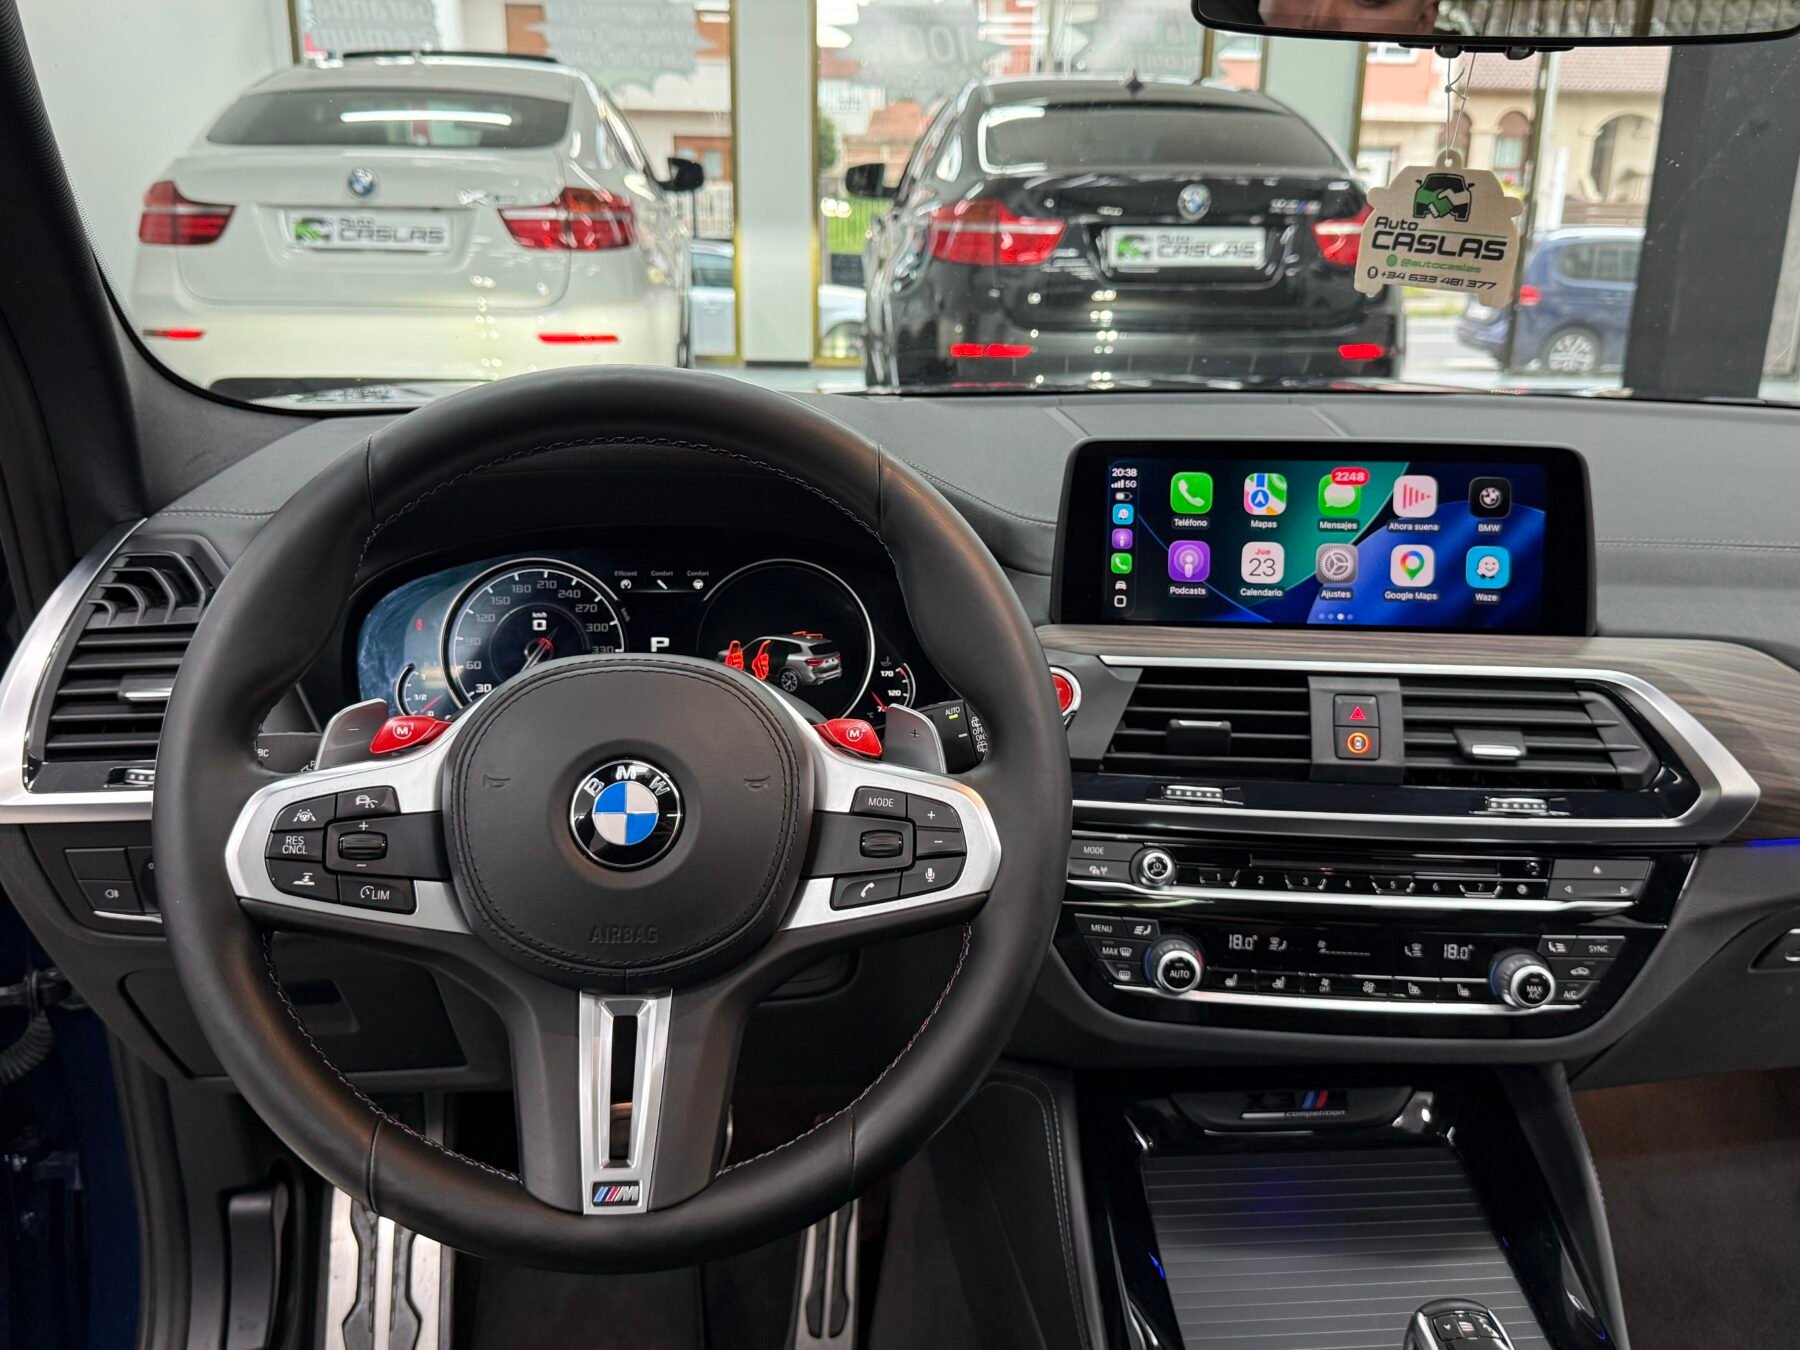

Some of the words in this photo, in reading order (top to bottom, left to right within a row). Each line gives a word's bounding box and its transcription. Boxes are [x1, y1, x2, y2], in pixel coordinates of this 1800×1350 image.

[1374, 216, 1418, 231] Auto
[340, 226, 445, 243] CASLAS
[1371, 230, 1507, 261] CASLAS
[1400, 258, 1482, 273] @autocaslas
[1381, 271, 1405, 280] +34
[1408, 274, 1437, 284] 633
[1440, 277, 1464, 287] 481
[1466, 279, 1497, 290] 377
[1111, 468, 1137, 477] 20:38
[1334, 472, 1365, 482] 2248
[1125, 480, 1137, 488] 5G
[1173, 518, 1208, 528] Teléfono
[1251, 520, 1278, 529] Mapas
[1320, 521, 1357, 531] Mensajes
[1389, 523, 1413, 531] Ahora
[1478, 524, 1500, 532] BMW
[1249, 558, 1276, 577] 23
[512, 584, 532, 593] 180
[537, 580, 557, 589] 210
[558, 589, 581, 598] 240
[1170, 586, 1206, 595] Podcasts
[1240, 588, 1283, 597] Calendario
[1321, 590, 1351, 599] Ajustes
[491, 596, 510, 605] 150
[1385, 591, 1413, 601] Google
[1414, 592, 1438, 601] Maps
[1475, 594, 1498, 602] Waze
[575, 604, 597, 613] 270
[476, 613, 495, 622] 120
[532, 619, 547, 631] 0
[586, 623, 608, 632] 300
[650, 637, 670, 652] P
[592, 646, 614, 654] 330
[466, 660, 482, 670] 60
[475, 683, 492, 693] 30
[414, 693, 427, 701] 1/2
[945, 706, 960, 716] AUTO
[584, 765, 670, 797] BMW
[868, 797, 894, 807] MODE
[286, 836, 305, 845] RES
[282, 845, 308, 854] CNCL
[1083, 846, 1105, 855] MODE
[1216, 873, 1221, 881] 1
[1257, 875, 1265, 885] 2
[1303, 877, 1310, 886] 3
[1344, 880, 1352, 888] 4
[1390, 880, 1396, 889] 5
[1433, 882, 1440, 892] 6
[371, 890, 390, 900] LIM
[1091, 924, 1112, 933] MENU
[590, 926, 659, 944] AIRBAG
[1102, 947, 1118, 956] MAX
[1588, 944, 1608, 953] SYNC
[1169, 969, 1190, 979] AUTO
[1526, 985, 1542, 993] MAX
[1563, 990, 1577, 998] A/C
